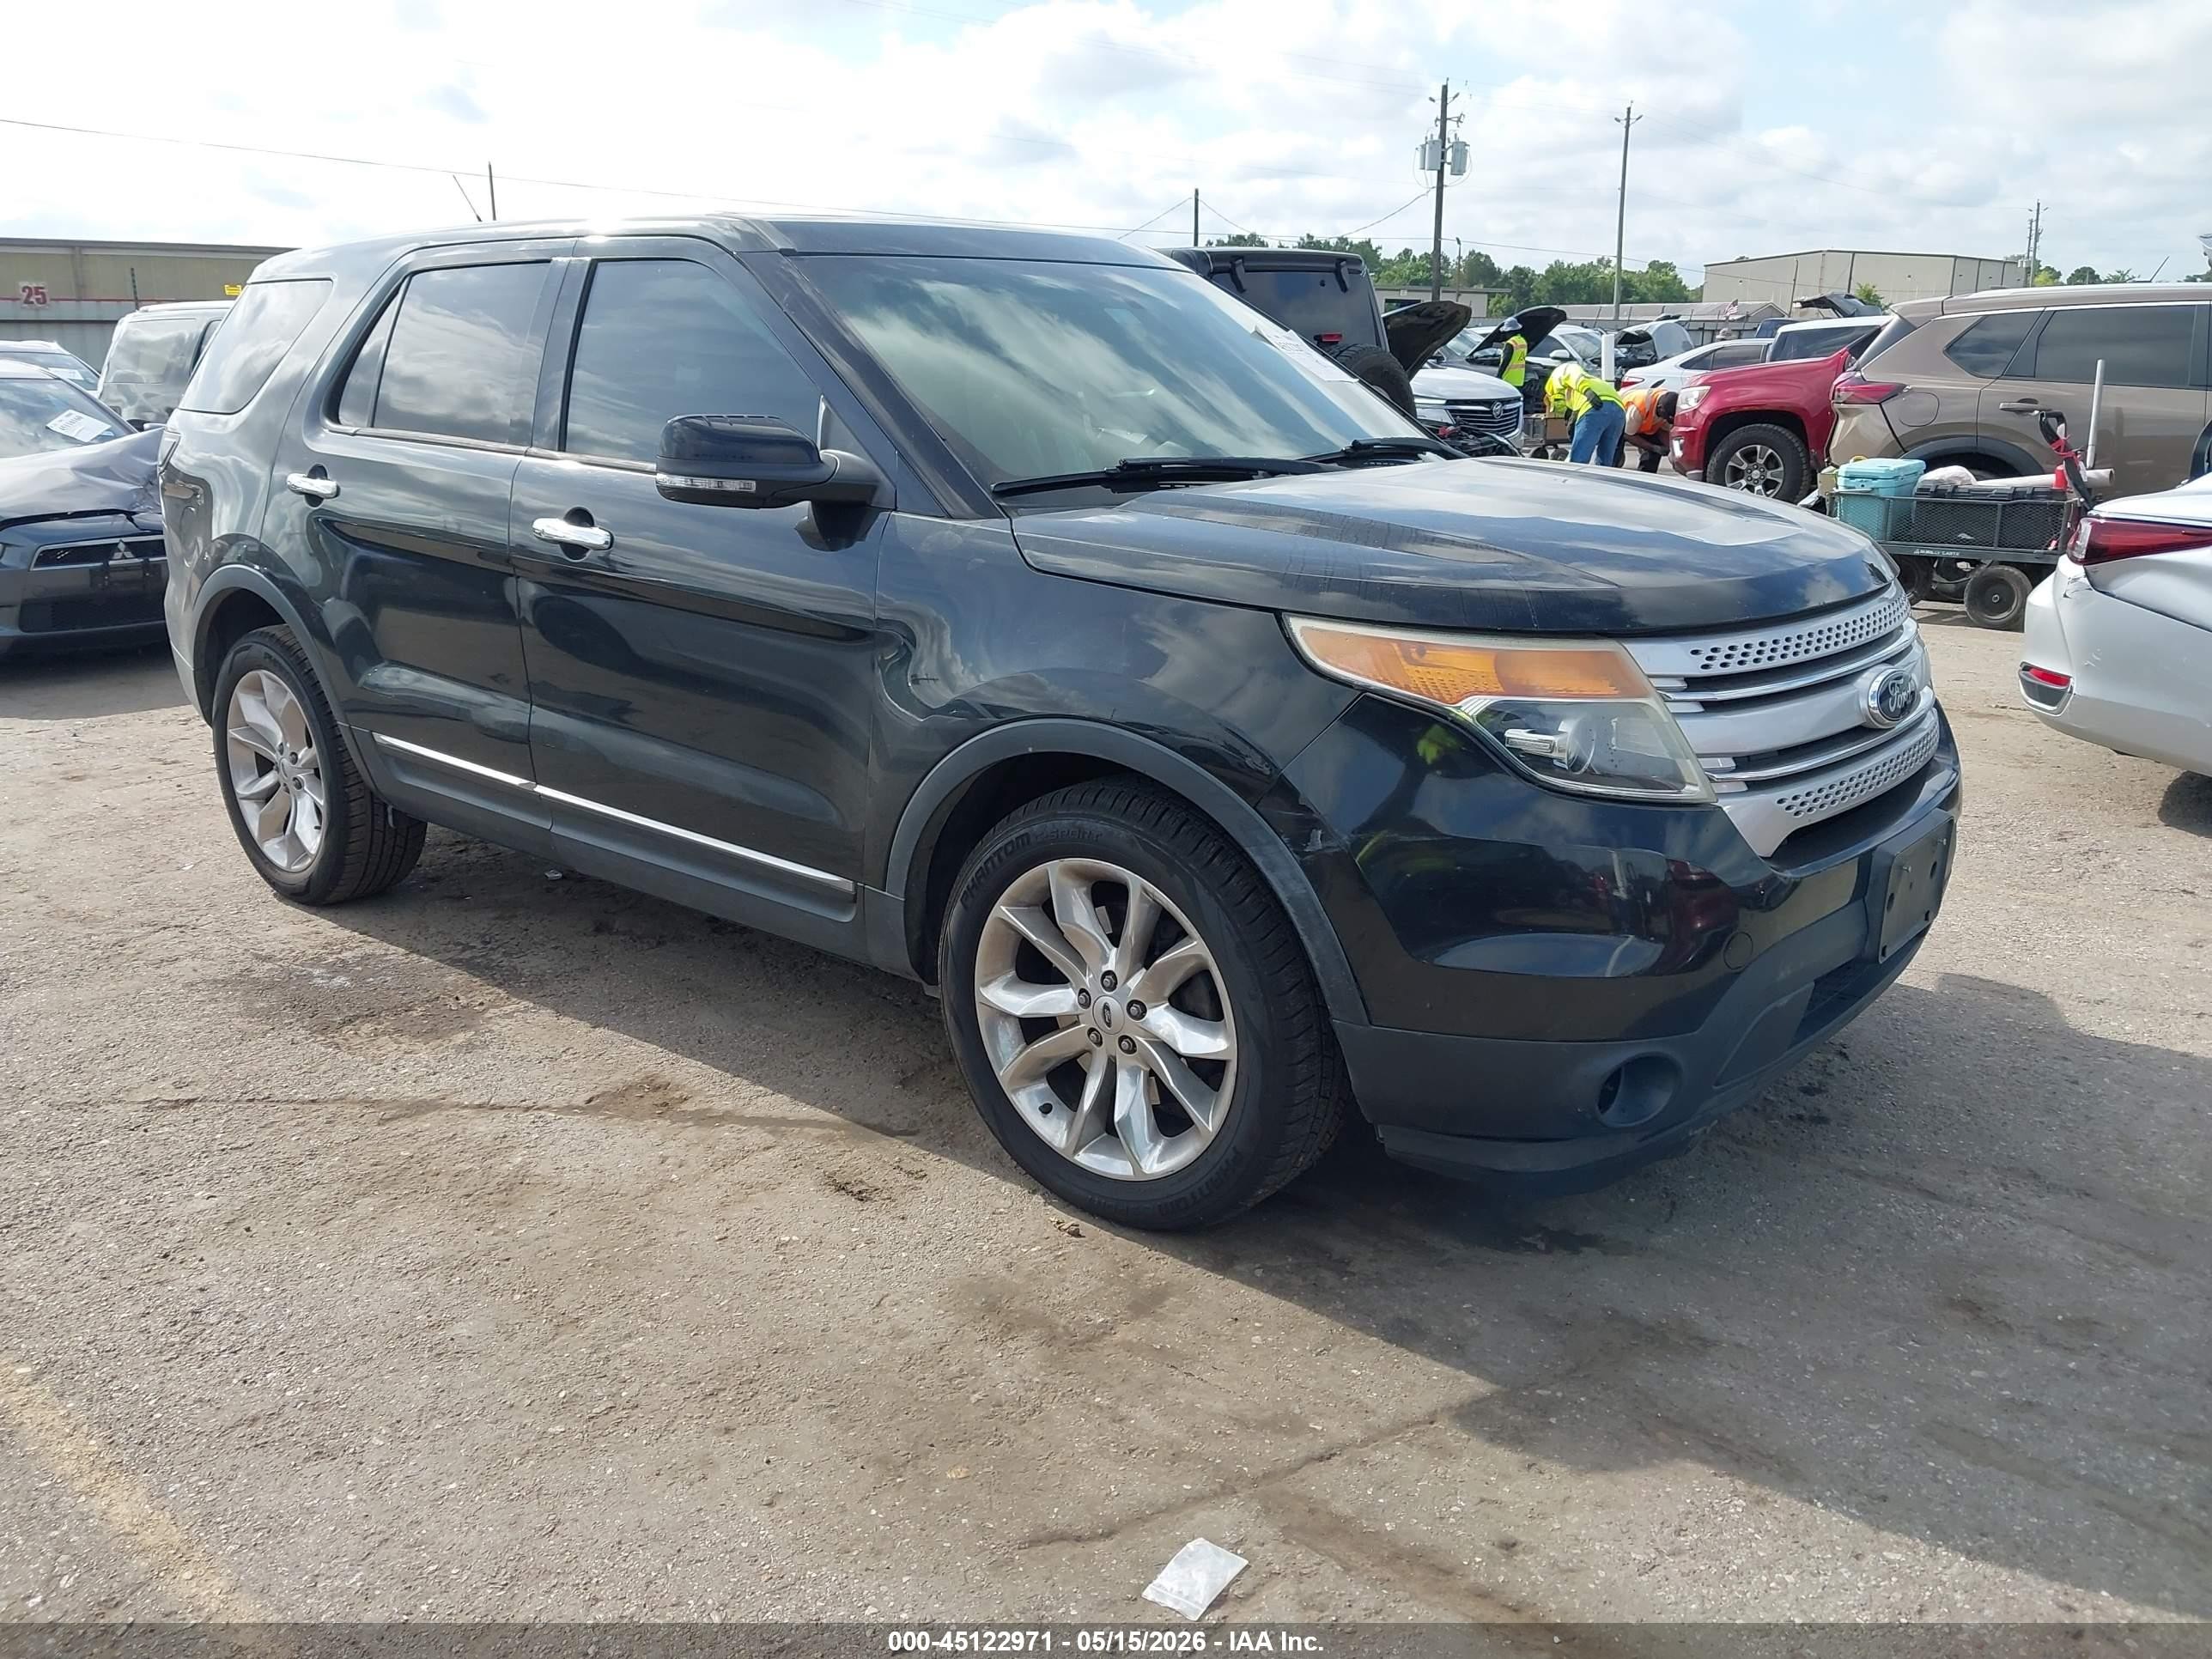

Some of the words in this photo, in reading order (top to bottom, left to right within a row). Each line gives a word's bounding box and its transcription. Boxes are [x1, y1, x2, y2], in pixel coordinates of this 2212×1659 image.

[21, 285, 47, 305] 25
[1888, 678, 1911, 713] Ford
[960, 831, 1030, 909] PHANTOM
